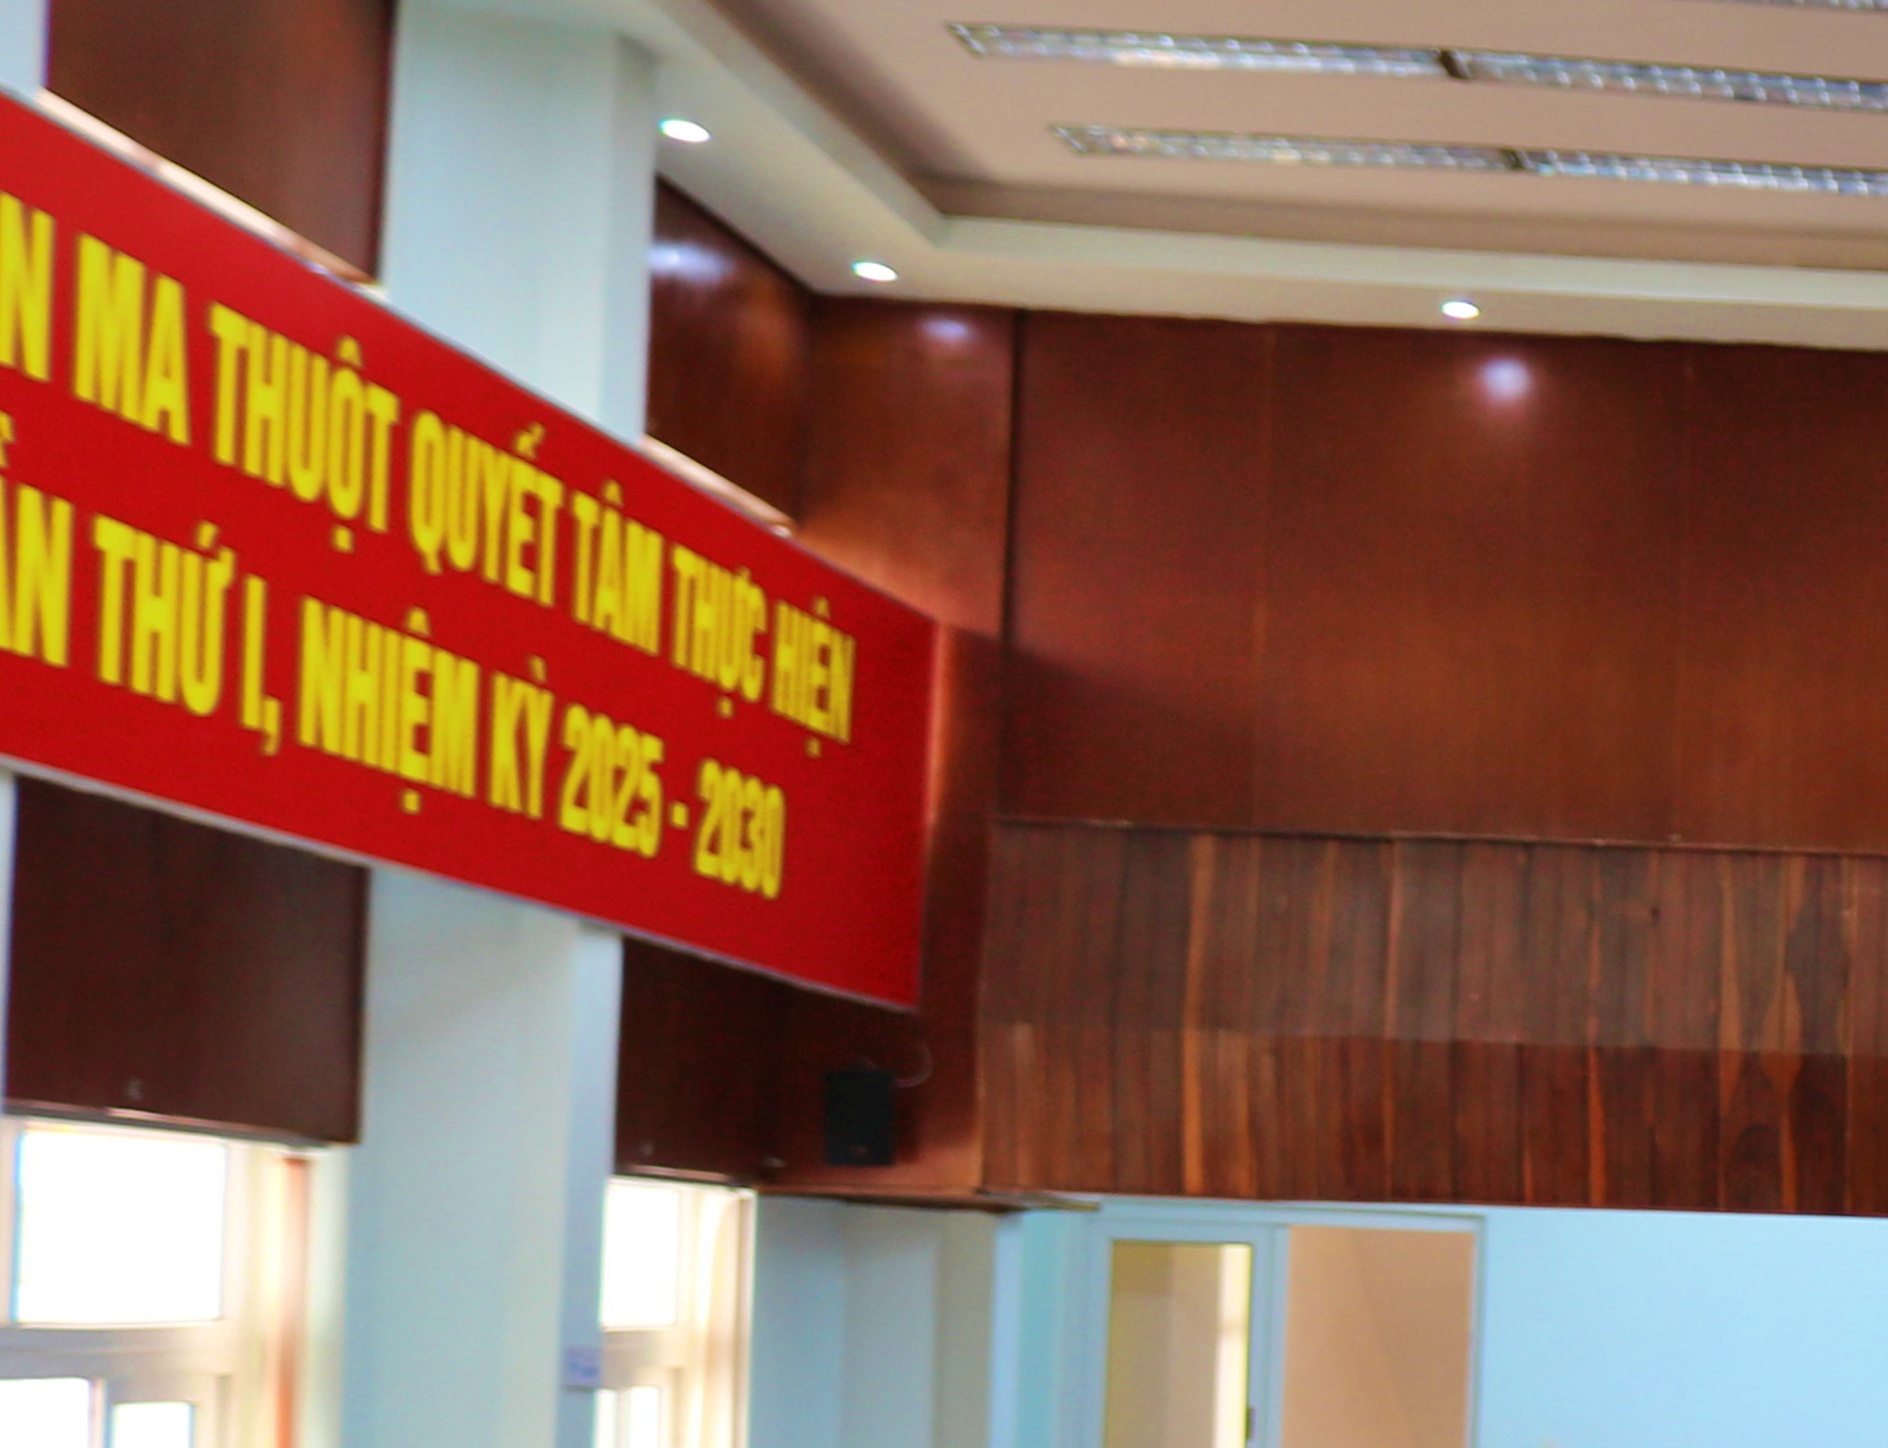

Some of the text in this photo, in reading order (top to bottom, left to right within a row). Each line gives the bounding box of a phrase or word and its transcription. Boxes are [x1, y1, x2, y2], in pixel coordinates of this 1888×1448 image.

[74, 232, 191, 446] MA
[208, 302, 399, 552] THUỘT
[409, 410, 564, 607] QUYẾT
[572, 480, 664, 657] TÂM
[672, 543, 767, 719] THỰC
[772, 597, 856, 759] HIỆN
[94, 514, 236, 717] THỨ
[242, 574, 282, 756] I,
[299, 597, 479, 814] NHIỆM
[489, 655, 554, 819] KỲ
[558, 703, 664, 859] 2025
[693, 758, 786, 900] 2030
